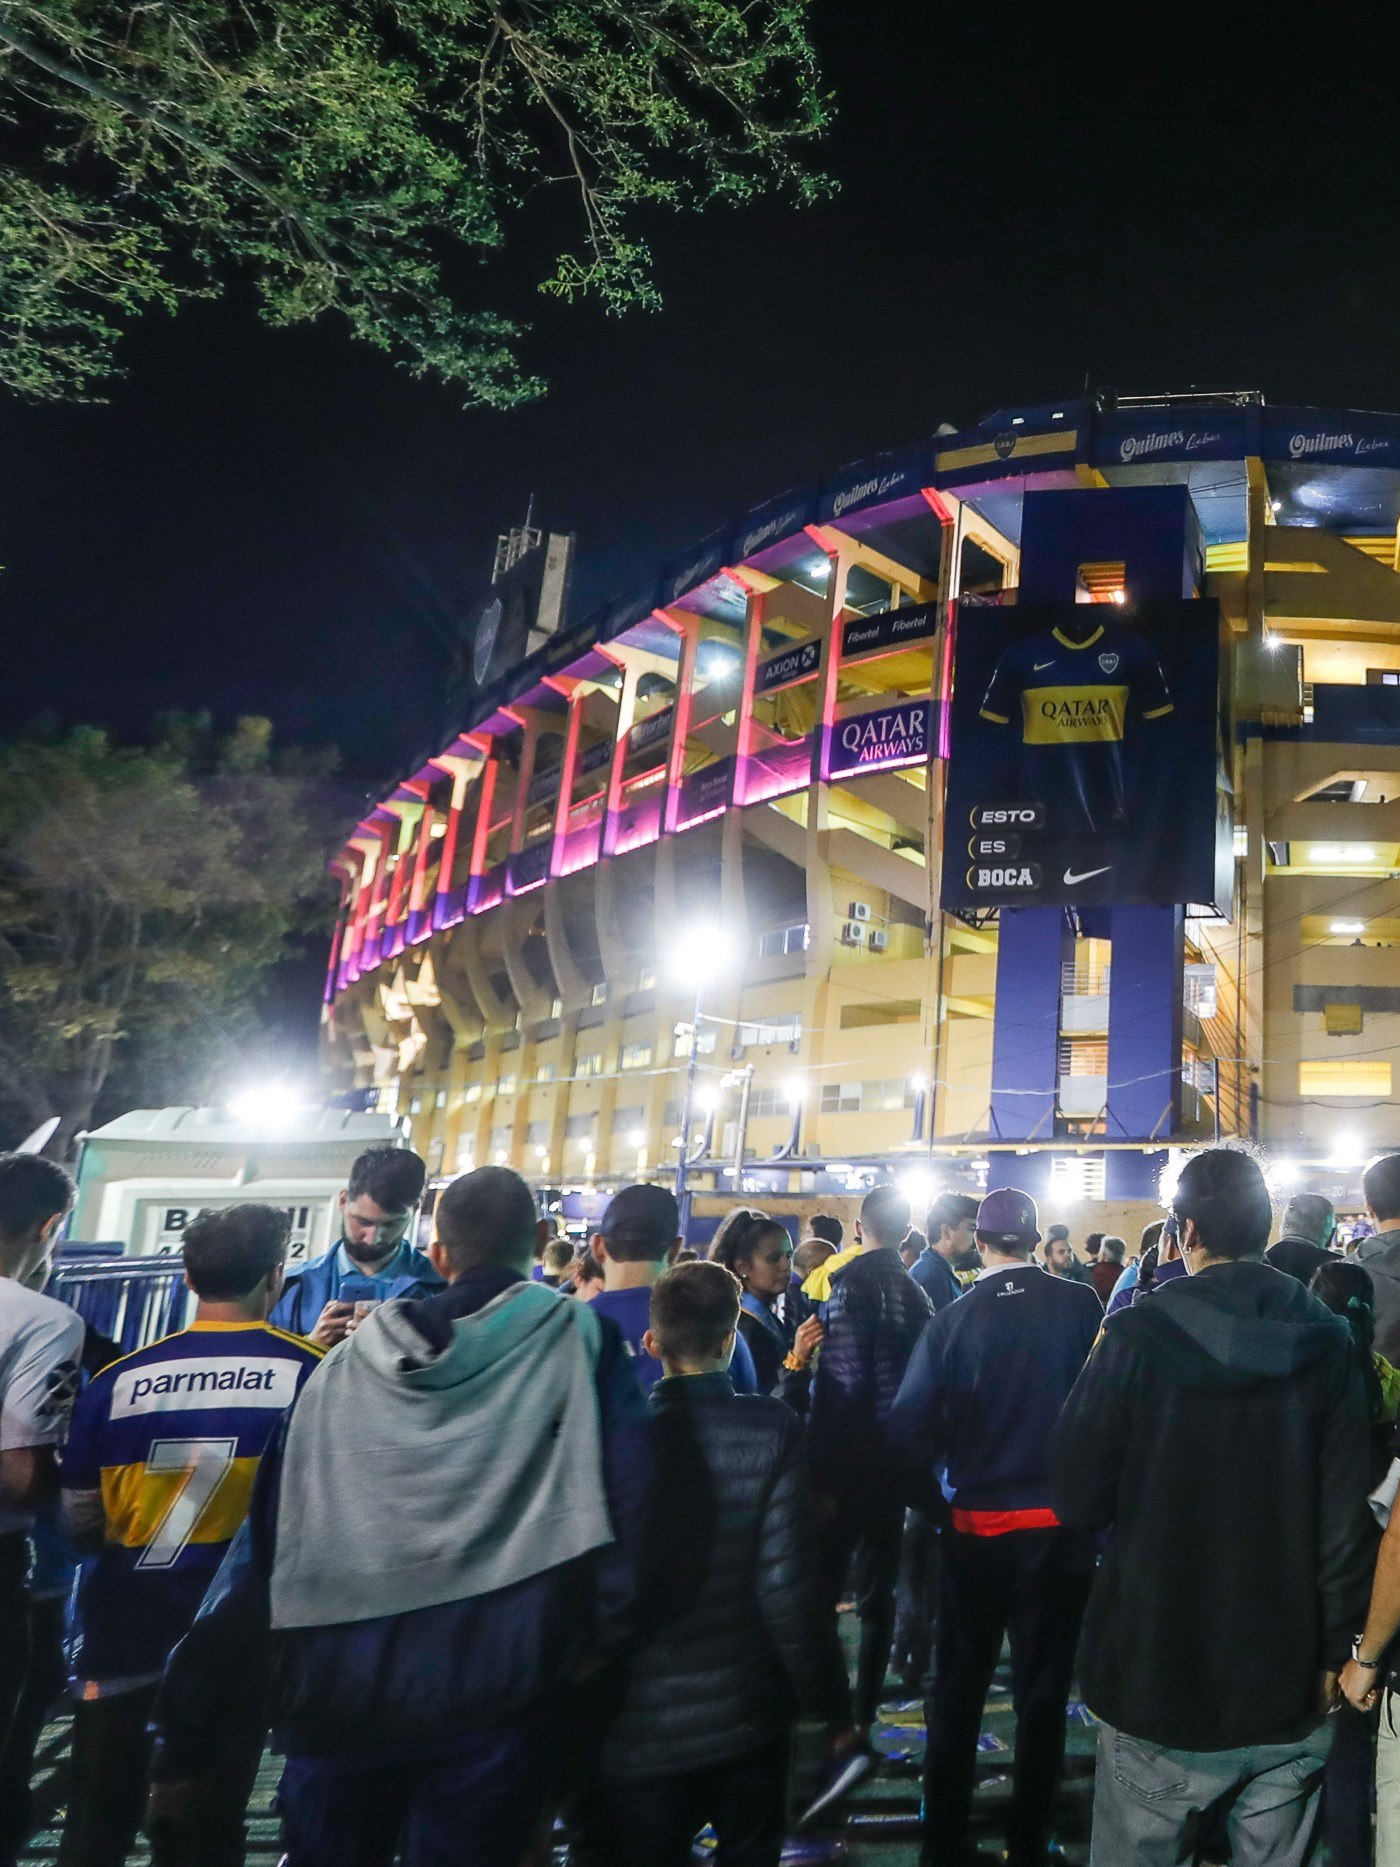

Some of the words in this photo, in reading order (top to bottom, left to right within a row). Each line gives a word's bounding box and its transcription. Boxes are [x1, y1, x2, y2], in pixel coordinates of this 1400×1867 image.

[1120, 430, 1184, 462] Quilmes
[1289, 432, 1353, 458] Quilmes
[834, 478, 878, 517] Quilmes
[847, 626, 879, 643] Fibertel
[892, 615, 927, 632] Fibertel
[765, 656, 799, 680] AXION
[1042, 699, 1109, 719] QATAR
[842, 709, 925, 752] QATAR
[859, 735, 923, 762] AIRWAYS
[981, 810, 1036, 823] ESTO
[980, 841, 1006, 853] ES
[977, 868, 1034, 886] BOCA
[129, 1367, 276, 1406] parmalat
[134, 1436, 239, 1570] 7
